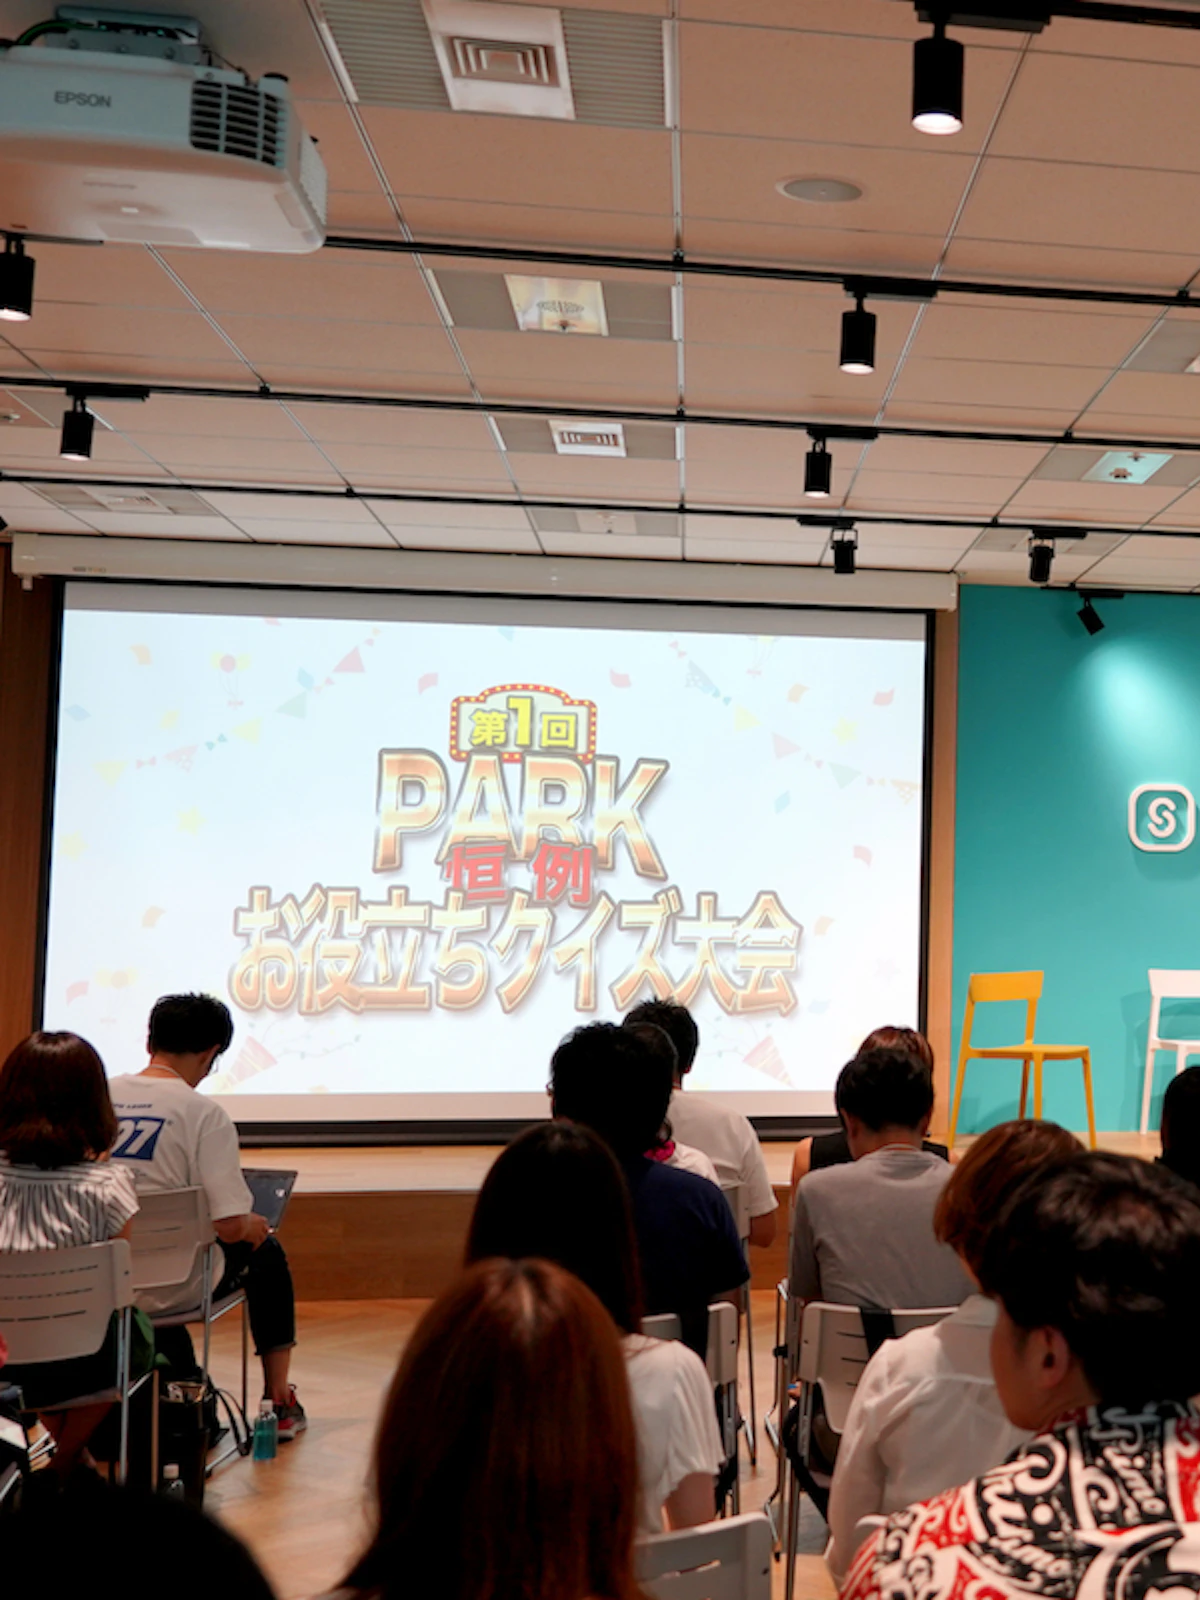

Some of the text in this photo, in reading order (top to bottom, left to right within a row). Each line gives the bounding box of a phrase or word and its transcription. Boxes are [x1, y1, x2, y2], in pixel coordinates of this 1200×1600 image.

[54, 90, 112, 108] EPSON
[469, 696, 578, 749] 第1回
[373, 748, 669, 880] PARK
[230, 884, 802, 1016] お役立ちクイズ大会
